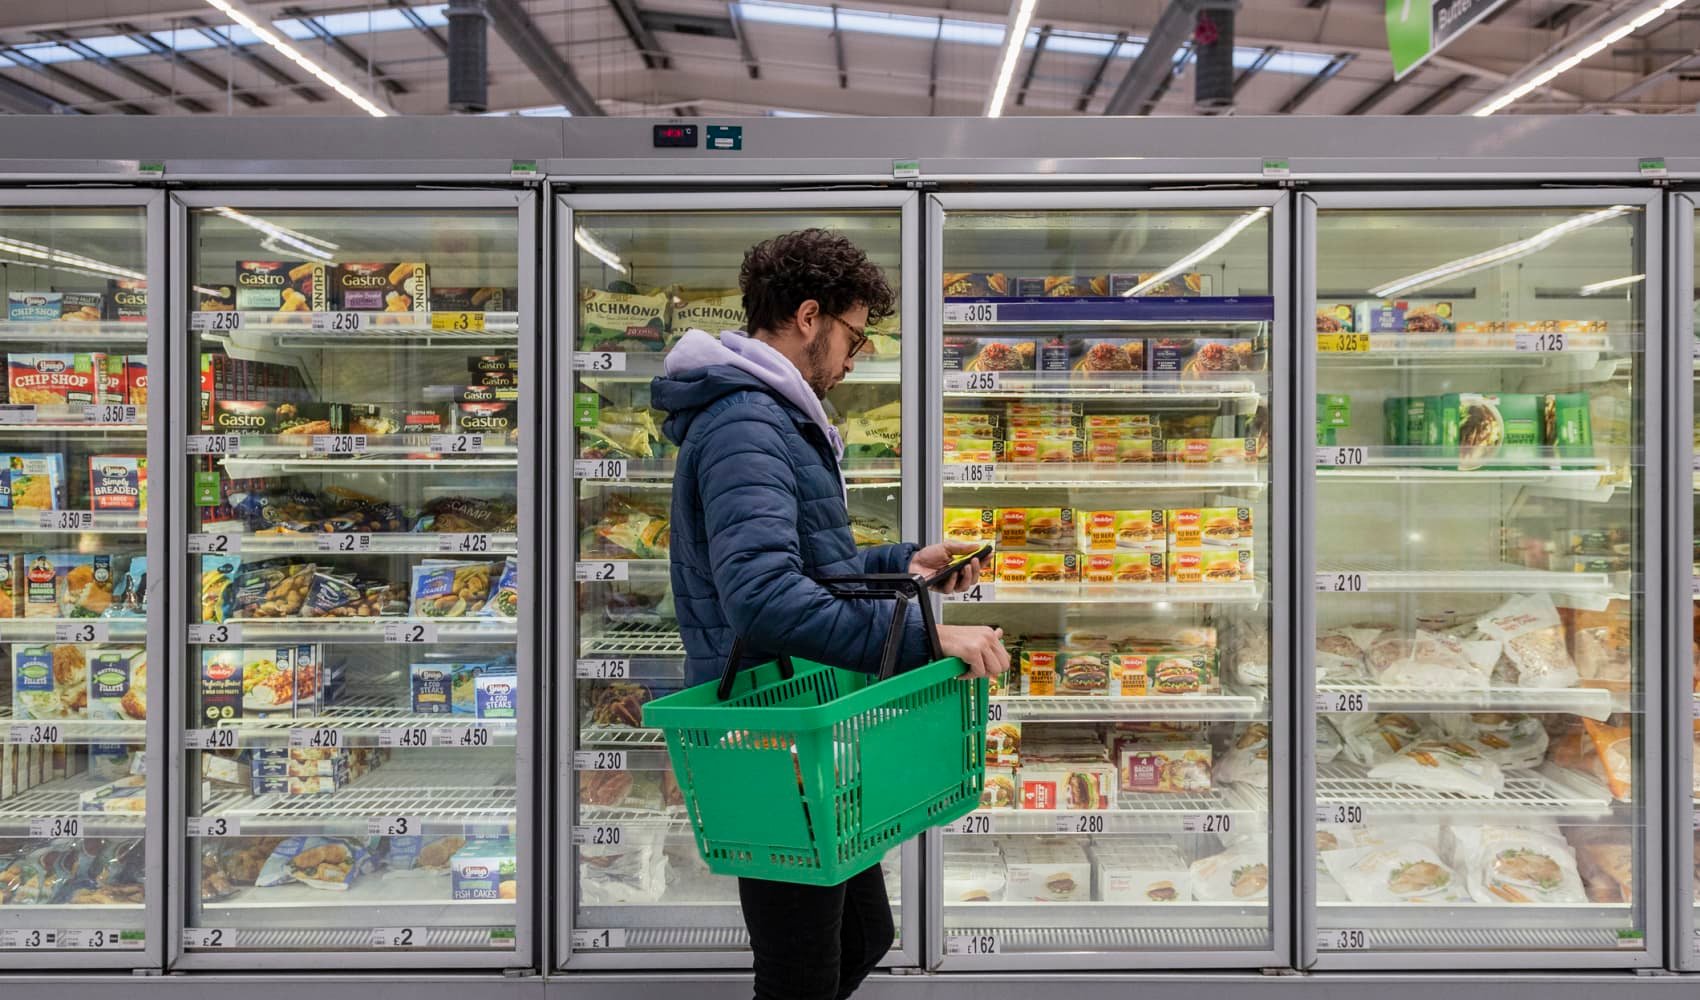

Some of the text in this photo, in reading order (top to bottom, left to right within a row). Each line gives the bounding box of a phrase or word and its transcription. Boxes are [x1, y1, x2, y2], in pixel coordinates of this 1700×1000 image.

[240, 273, 284, 285] Gastro
[342, 274, 386, 286] Gastro
[585, 302, 660, 317] RICHMOND
[454, 314, 468, 330] £3
[478, 362, 505, 370] Gastro
[593, 353, 612, 370] £3
[15, 374, 88, 388] CHIP SHOP
[482, 377, 509, 386] Gastro
[464, 391, 492, 400] Gastro
[219, 414, 265, 426] Gastro
[461, 416, 508, 428] Gastro
[452, 436, 466, 452] £2
[95, 486, 138, 496] BREADED
[102, 478, 129, 488] Simply
[208, 535, 228, 552] £2
[340, 534, 354, 550] £2
[596, 563, 615, 580] £2
[963, 585, 982, 601] £4
[76, 625, 95, 642] £3
[208, 626, 228, 642] £3
[405, 625, 424, 642] £2
[486, 701, 512, 709] STEAKS
[208, 818, 227, 836] £3
[388, 818, 408, 834] £3
[455, 890, 497, 898] FISH CAKES
[26, 930, 40, 946] £3
[89, 931, 104, 947] £3
[202, 930, 222, 946] £2
[394, 928, 413, 946] £2
[592, 930, 610, 947] £1
